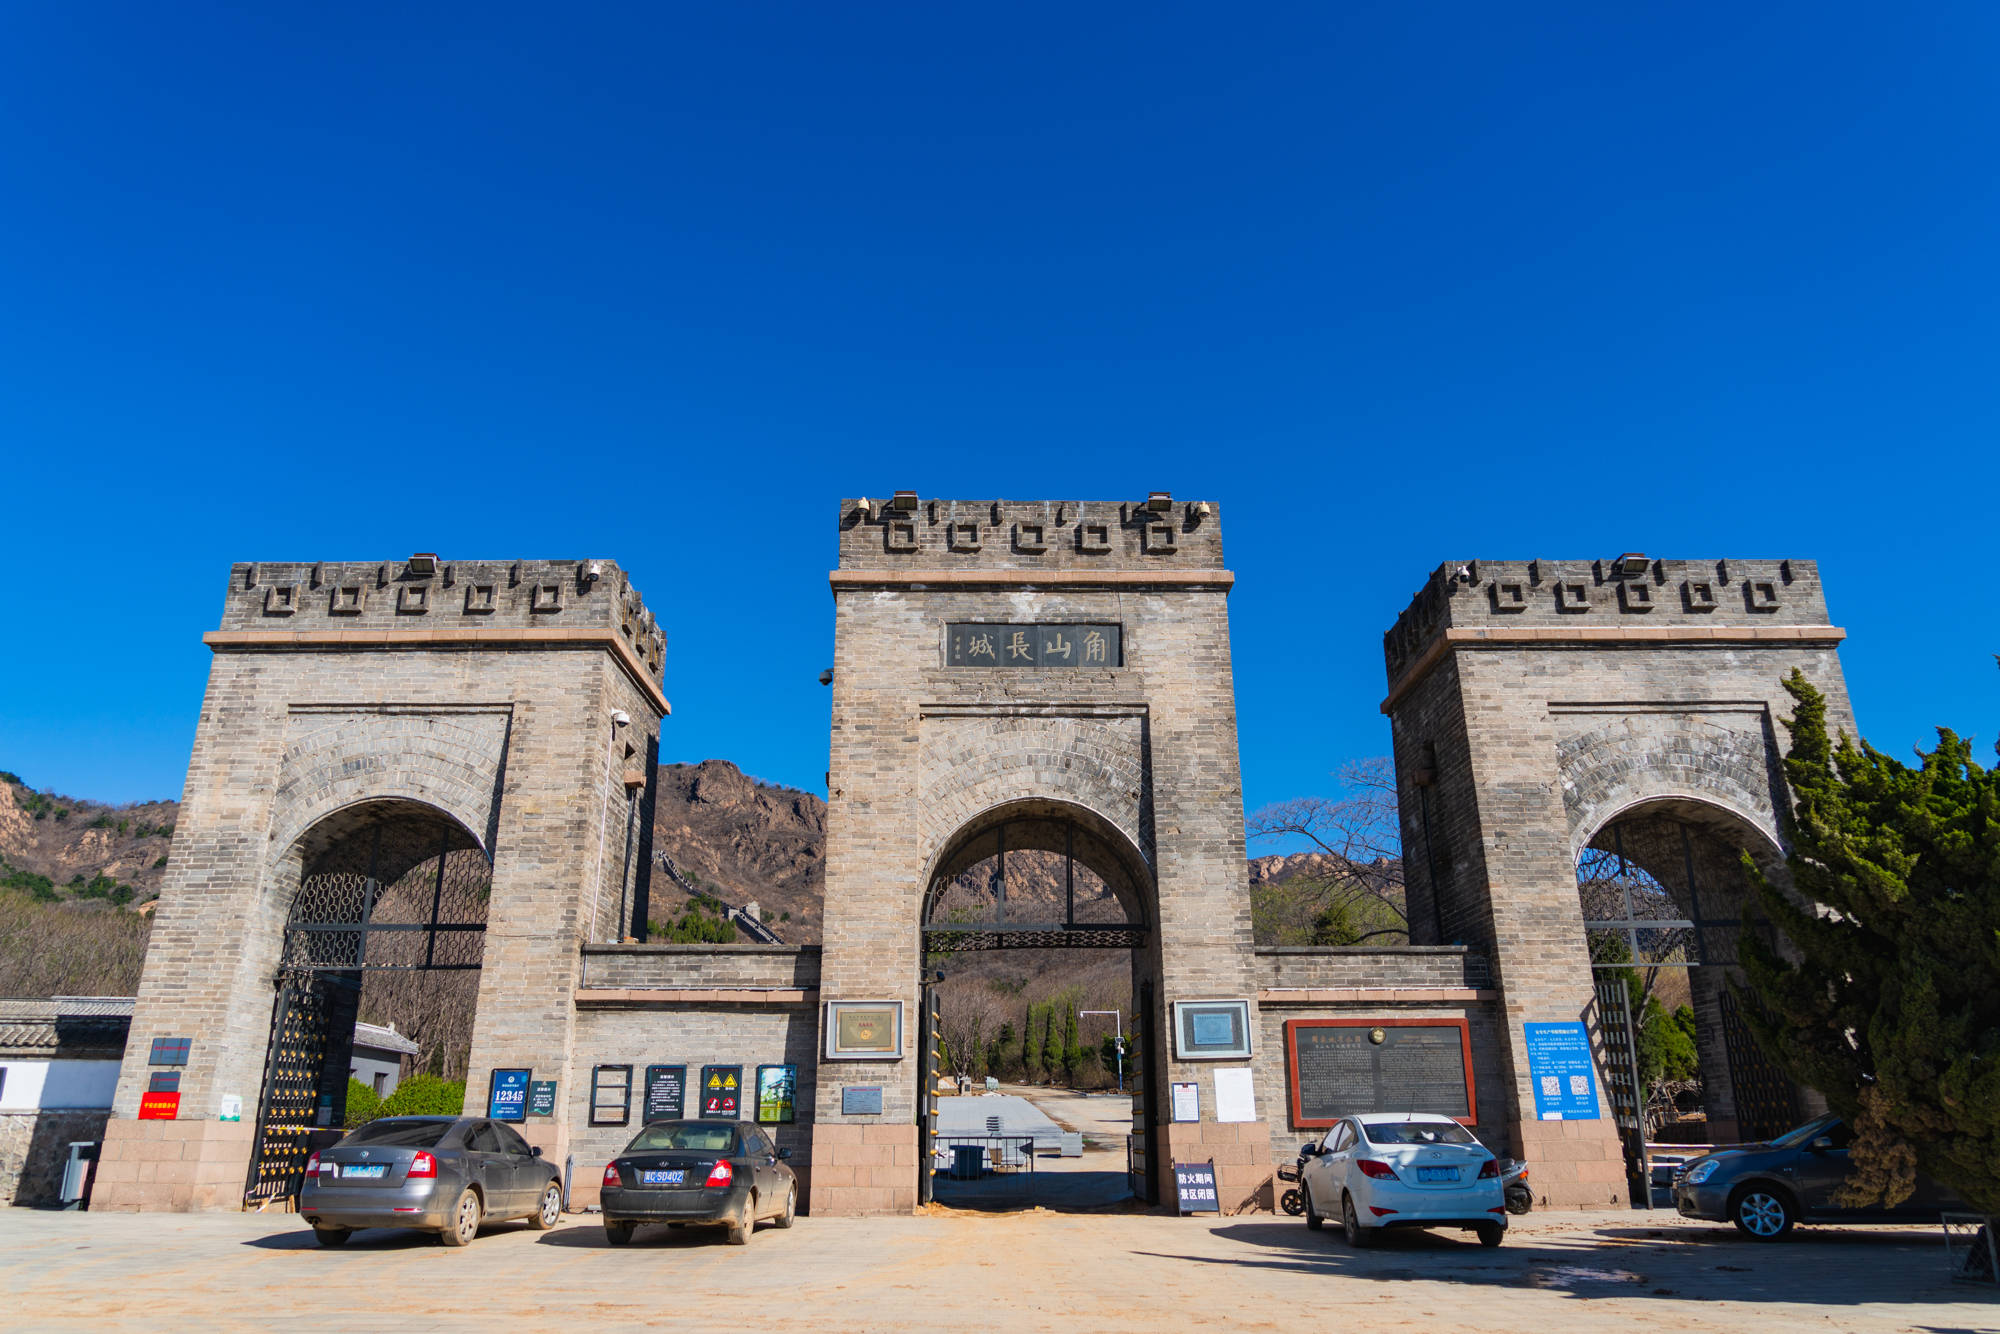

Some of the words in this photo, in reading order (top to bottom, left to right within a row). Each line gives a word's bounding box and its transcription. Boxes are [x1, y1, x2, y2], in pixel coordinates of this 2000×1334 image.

[968, 631, 1106, 661] 角山長城
[495, 1090, 524, 1102] 12345
[1177, 1173, 1213, 1184] 防火期间
[1180, 1188, 1215, 1200] 景区闭园
